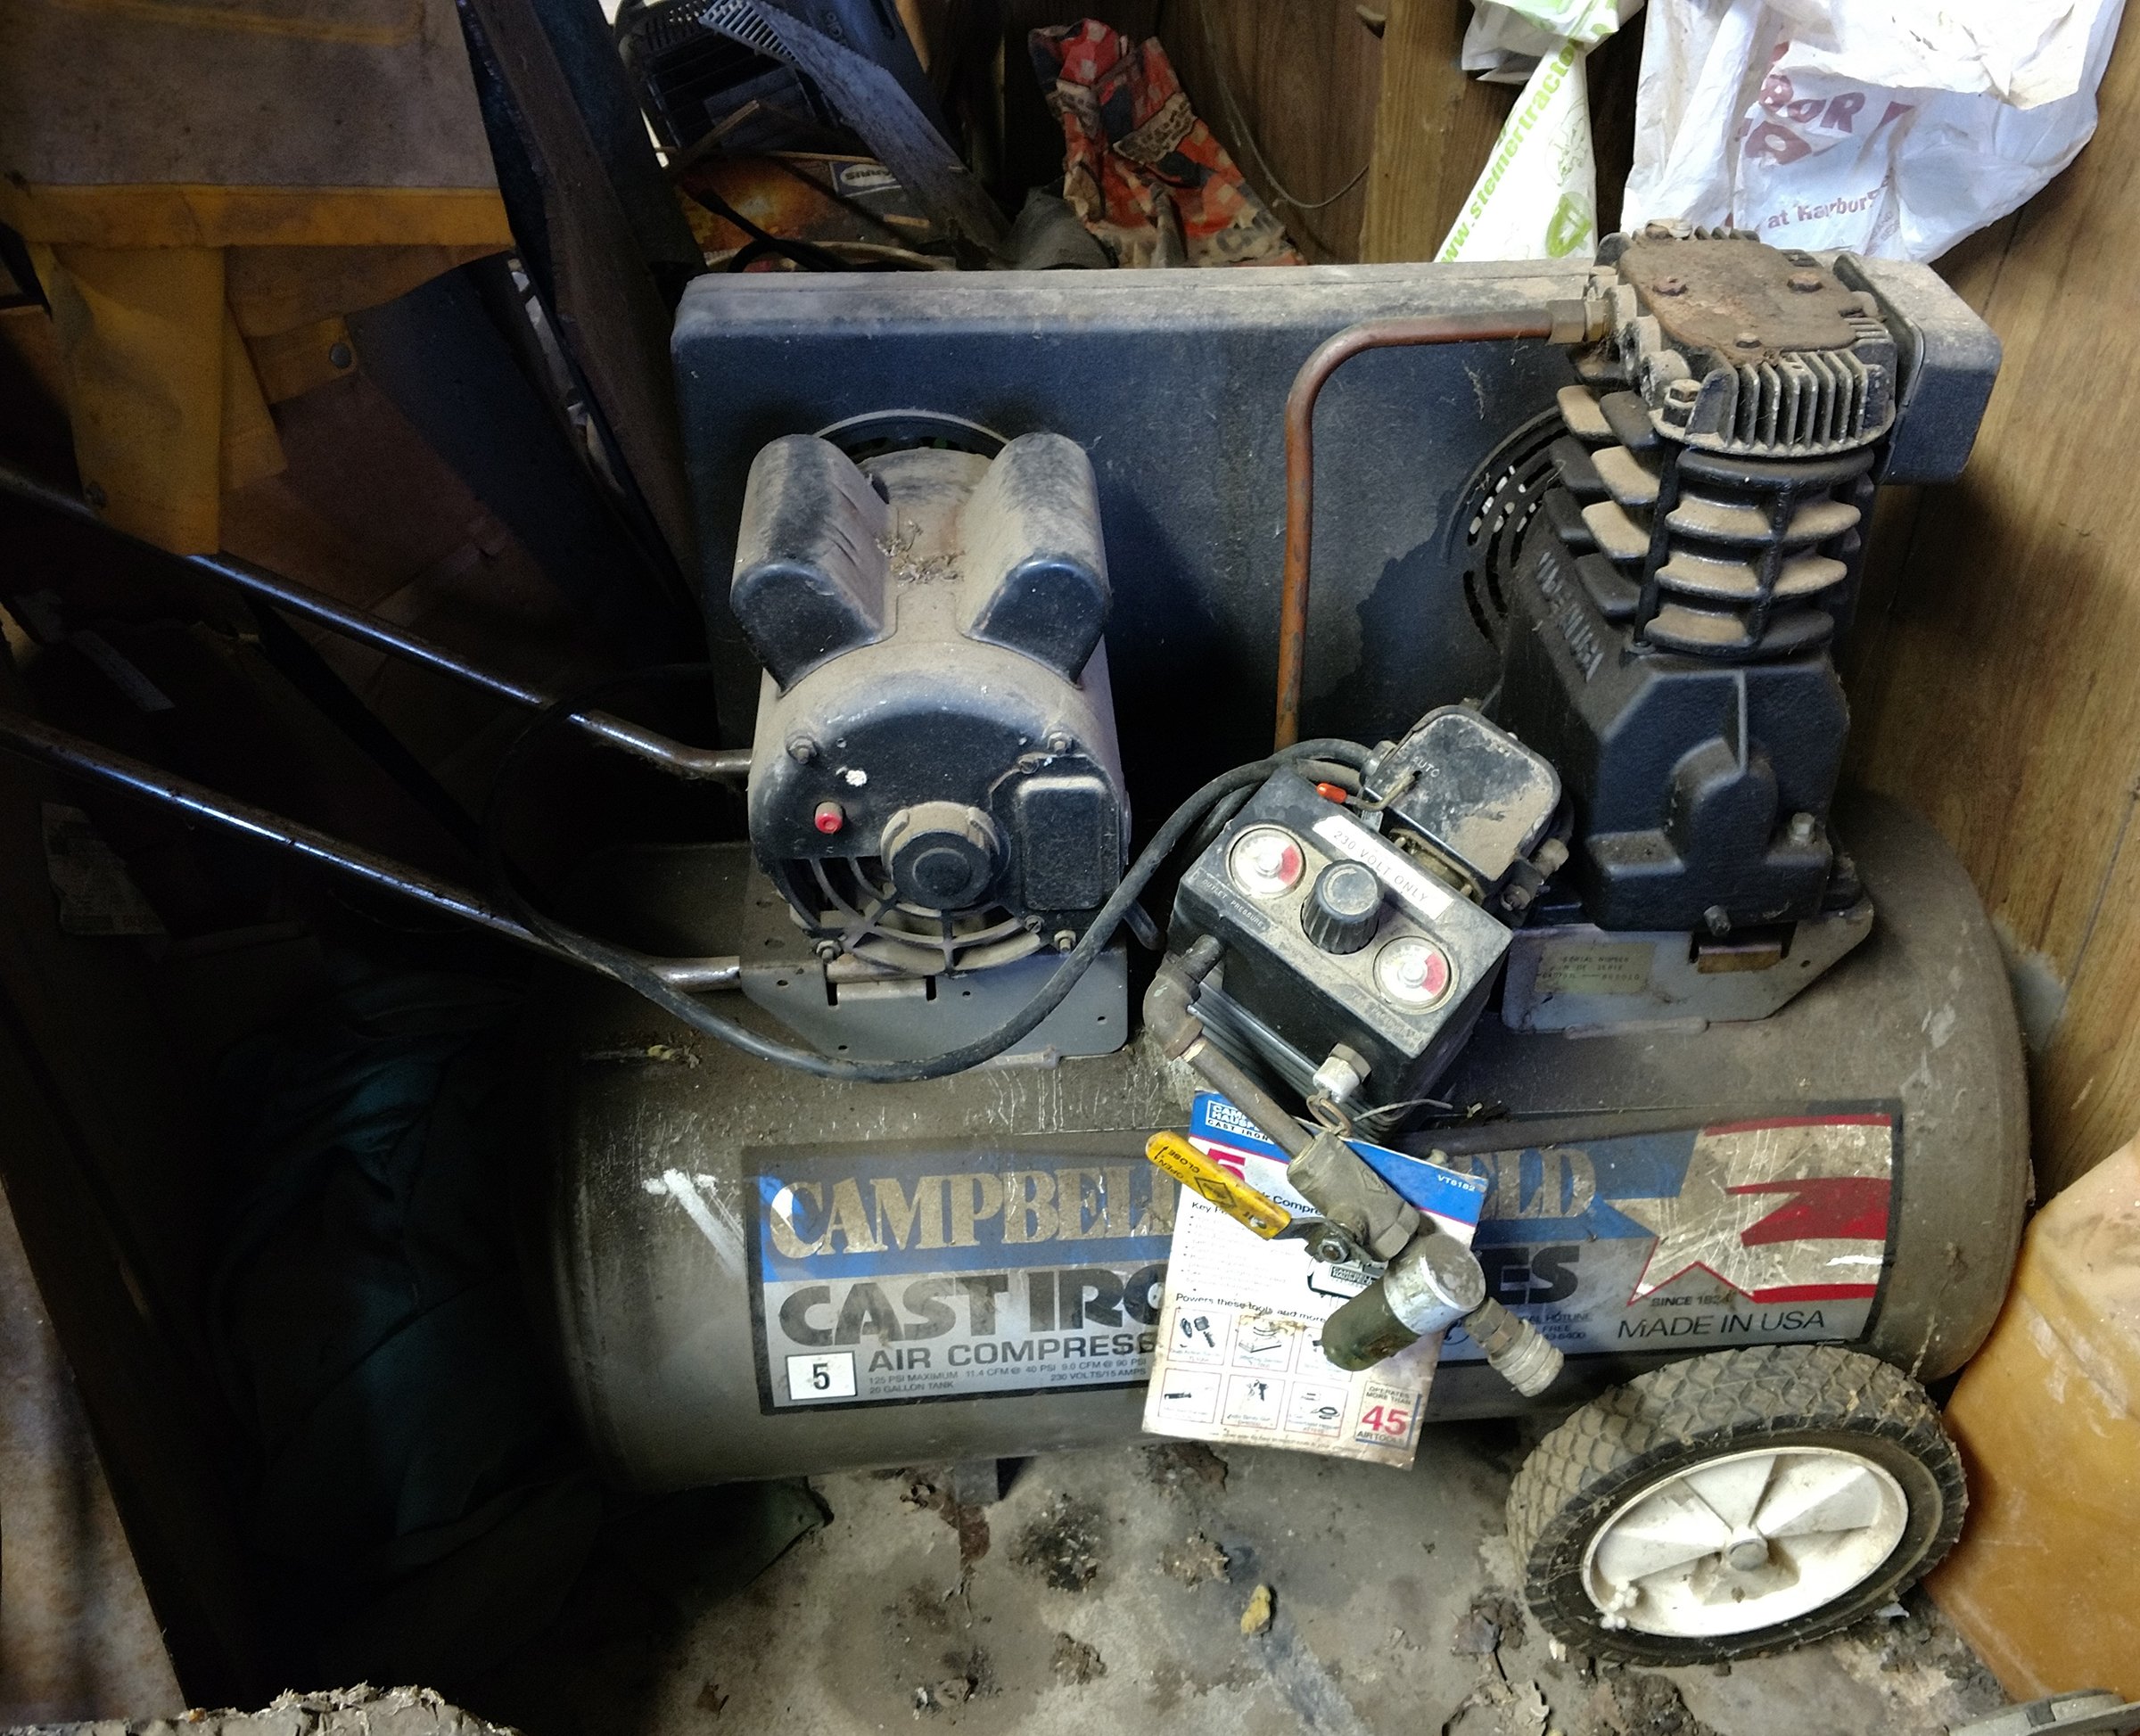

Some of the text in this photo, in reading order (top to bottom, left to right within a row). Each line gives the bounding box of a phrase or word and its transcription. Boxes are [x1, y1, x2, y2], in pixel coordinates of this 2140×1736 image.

[1767, 210, 1790, 228] at
[1412, 756, 1440, 777] AUTO
[1333, 830, 1428, 902] 230 VOLT ONLY
[1201, 878, 1264, 927] OUTLET PRESSURE
[1207, 1119, 1269, 1141] CAST IRON
[1158, 1159, 1185, 1180] OPEN
[1168, 1148, 1201, 1174] CLOSE
[1191, 1201, 1212, 1214] Key
[778, 1263, 1166, 1347] CAST IRO
[1175, 1293, 1214, 1304] Powers
[1277, 1308, 1296, 1318] and
[1299, 1313, 1326, 1323] more
[1650, 1296, 1692, 1307] SINCE
[1617, 1310, 1825, 1338] MADE IN USA
[868, 1347, 932, 1373] AIR
[948, 1331, 1158, 1367] COMPRESS
[811, 1362, 830, 1391] 5
[869, 1376, 886, 1384] 125
[888, 1374, 905, 1383] PSI
[907, 1370, 959, 1382] MAXIMUM
[986, 1367, 1009, 1376] CFM
[1025, 1365, 1037, 1373] 40
[1040, 1363, 1057, 1372] PSI
[1079, 1361, 1101, 1370] CFM
[1115, 1359, 1128, 1367] 90
[1131, 1358, 1147, 1366] PSI
[1050, 1373, 1068, 1381] 230
[1117, 1368, 1147, 1377] AMPS
[869, 1380, 954, 1395] 20 GALLON TANK
[1366, 1391, 1412, 1405] MORE THAN
[1369, 1386, 1411, 1399] OPERATES
[1362, 1404, 1409, 1436] 45
